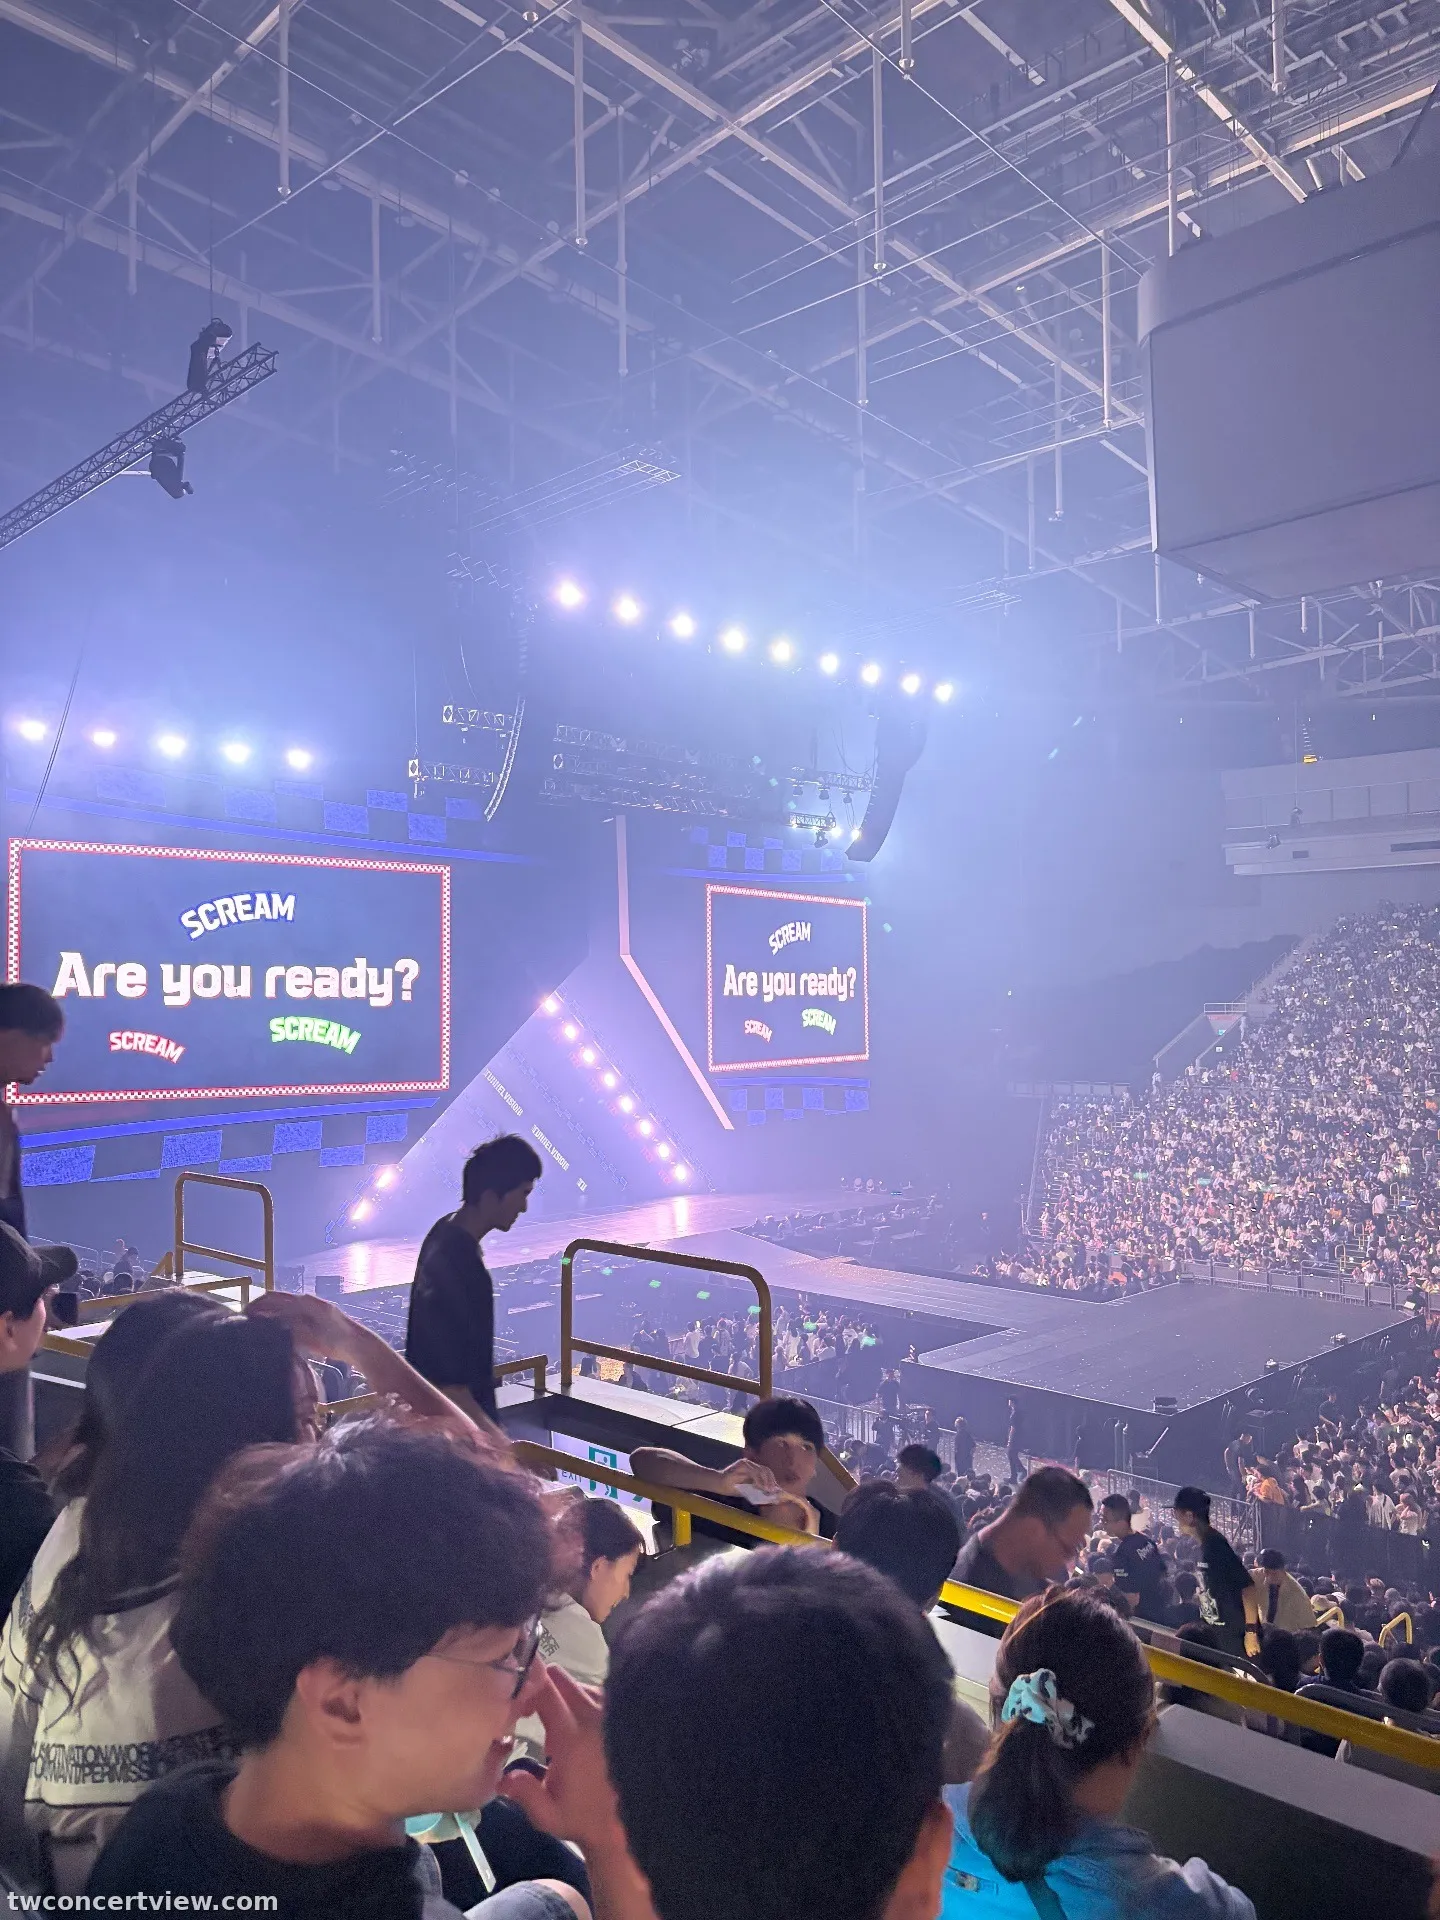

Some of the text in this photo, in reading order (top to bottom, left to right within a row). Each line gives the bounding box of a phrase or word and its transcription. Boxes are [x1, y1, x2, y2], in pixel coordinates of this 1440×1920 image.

[180, 892, 296, 940] SCREAM
[768, 921, 812, 956] SCREAM
[52, 951, 420, 1007] Are you ready?
[723, 964, 857, 1003] Are you ready?
[269, 1016, 362, 1055] SCREAM
[744, 1019, 773, 1043] SCREAM
[801, 1008, 837, 1036] SCREAM
[109, 1030, 185, 1064] SCREAM
